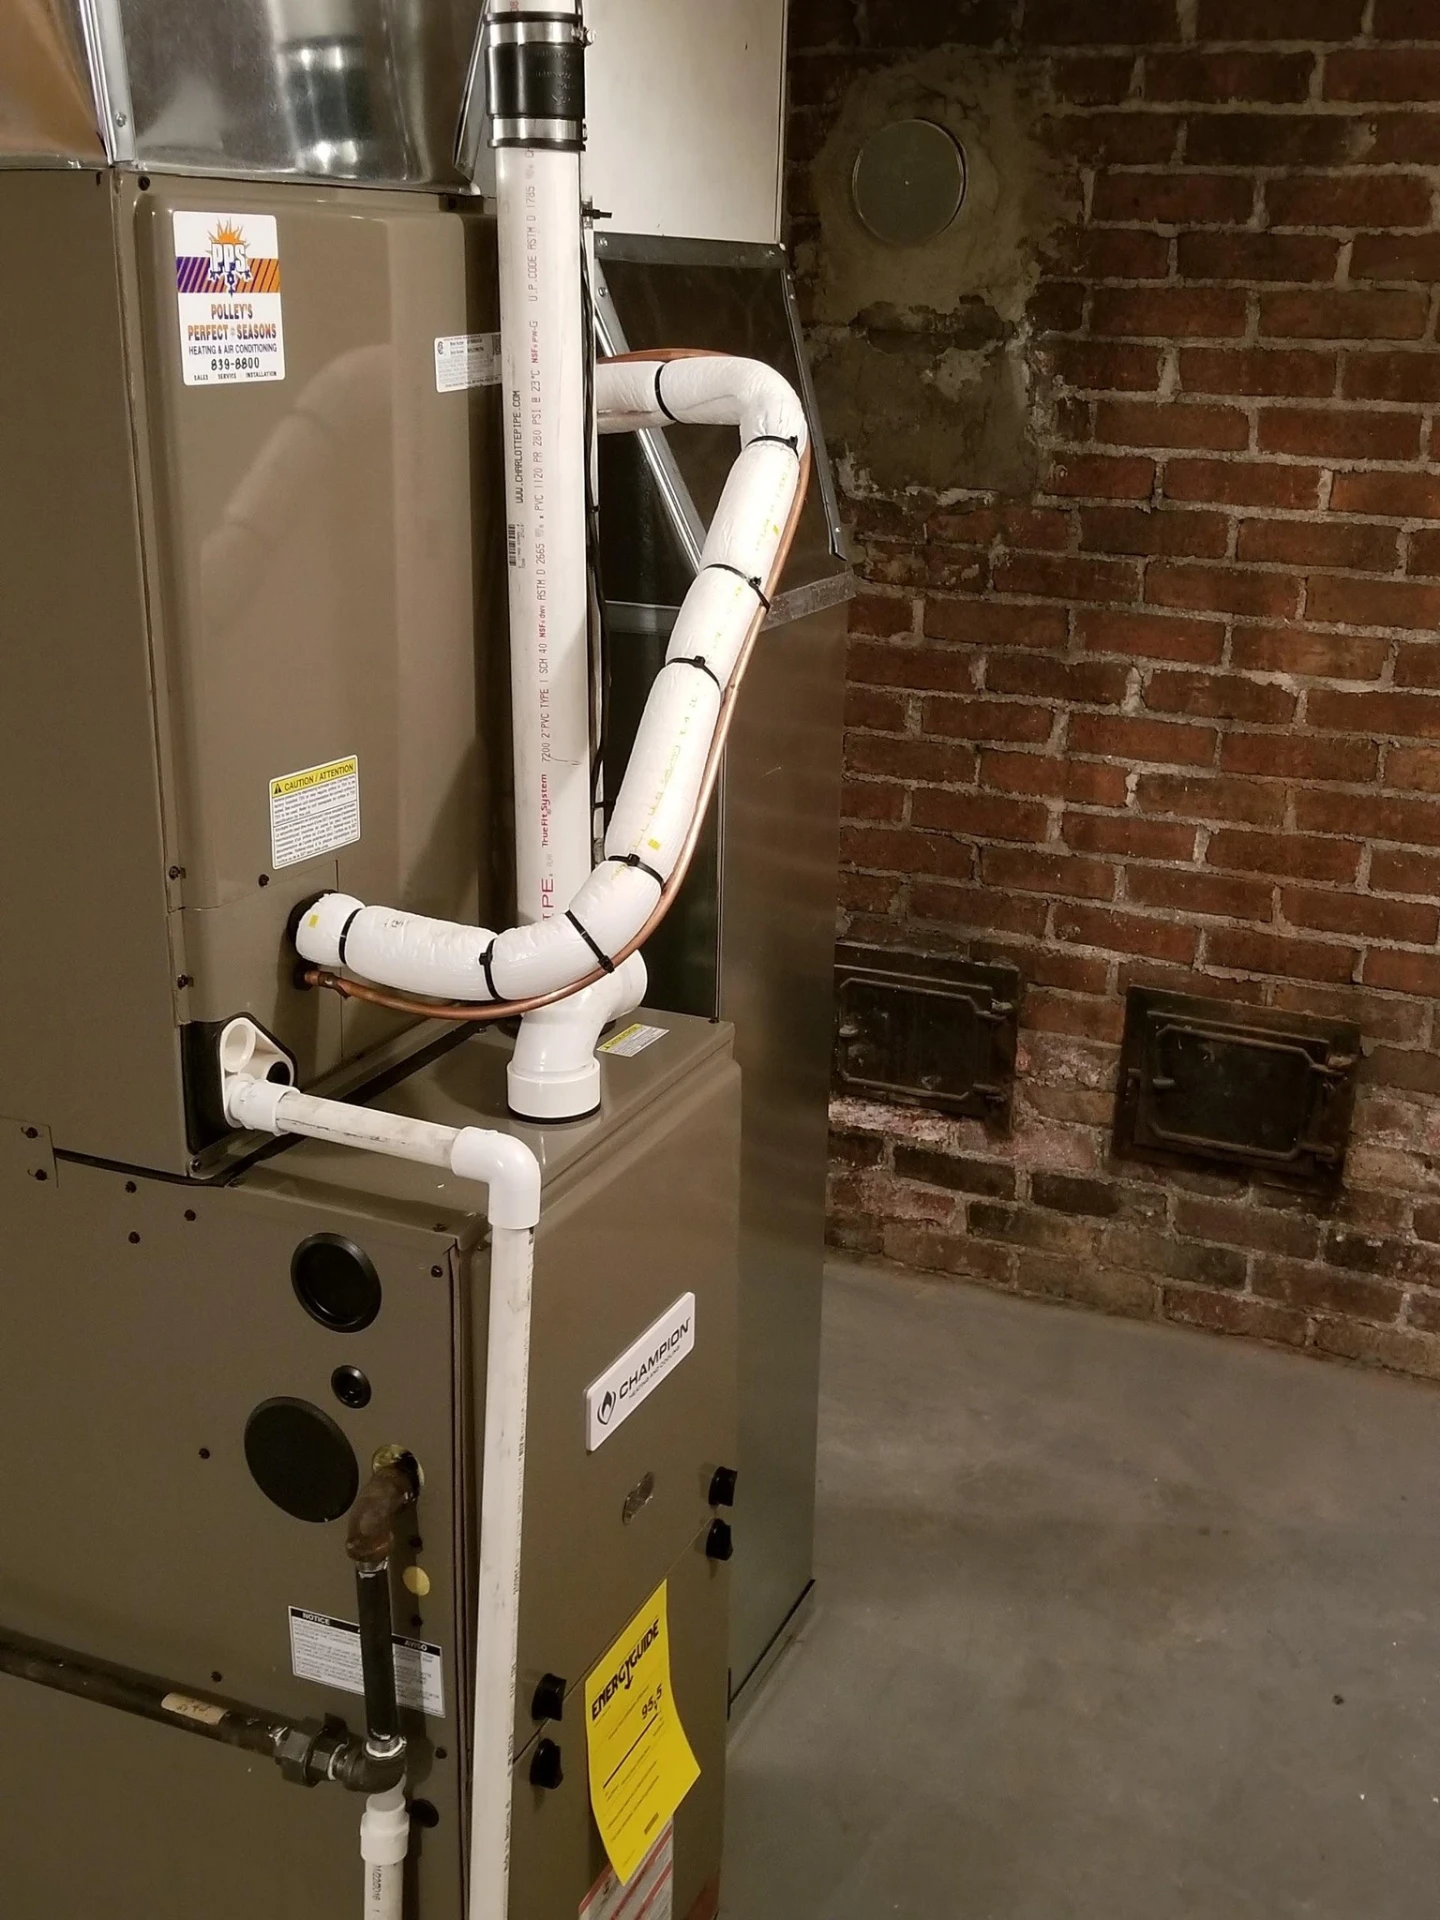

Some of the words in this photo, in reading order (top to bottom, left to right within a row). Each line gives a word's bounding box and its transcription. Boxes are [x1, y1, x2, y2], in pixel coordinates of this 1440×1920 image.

[526, 226, 537, 250] ASTM
[212, 243, 248, 273] PPS
[211, 303, 253, 320] POLLEY'S
[188, 324, 228, 341] PERFECT
[236, 323, 277, 340] SEASONS
[189, 345, 216, 355] HEATING
[218, 345, 222, 354] &
[224, 344, 234, 354] AIR
[235, 343, 277, 353] CONDITIONING
[211, 357, 260, 371] 839-8800
[531, 409, 542, 425] PSI
[532, 430, 543, 447] 280
[532, 452, 543, 463] PR
[534, 494, 544, 511] PVC
[535, 543, 546, 565] 2665
[536, 579, 546, 600] ASTM
[538, 643, 548, 654] 40
[538, 658, 549, 674] SCH
[540, 688, 550, 708] TYPE
[284, 775, 314, 791] CAUTION
[320, 763, 354, 780] ATTENTION
[540, 774, 551, 811] System
[619, 1319, 690, 1399] CHAMPION
[302, 1612, 331, 1626] NOTICE
